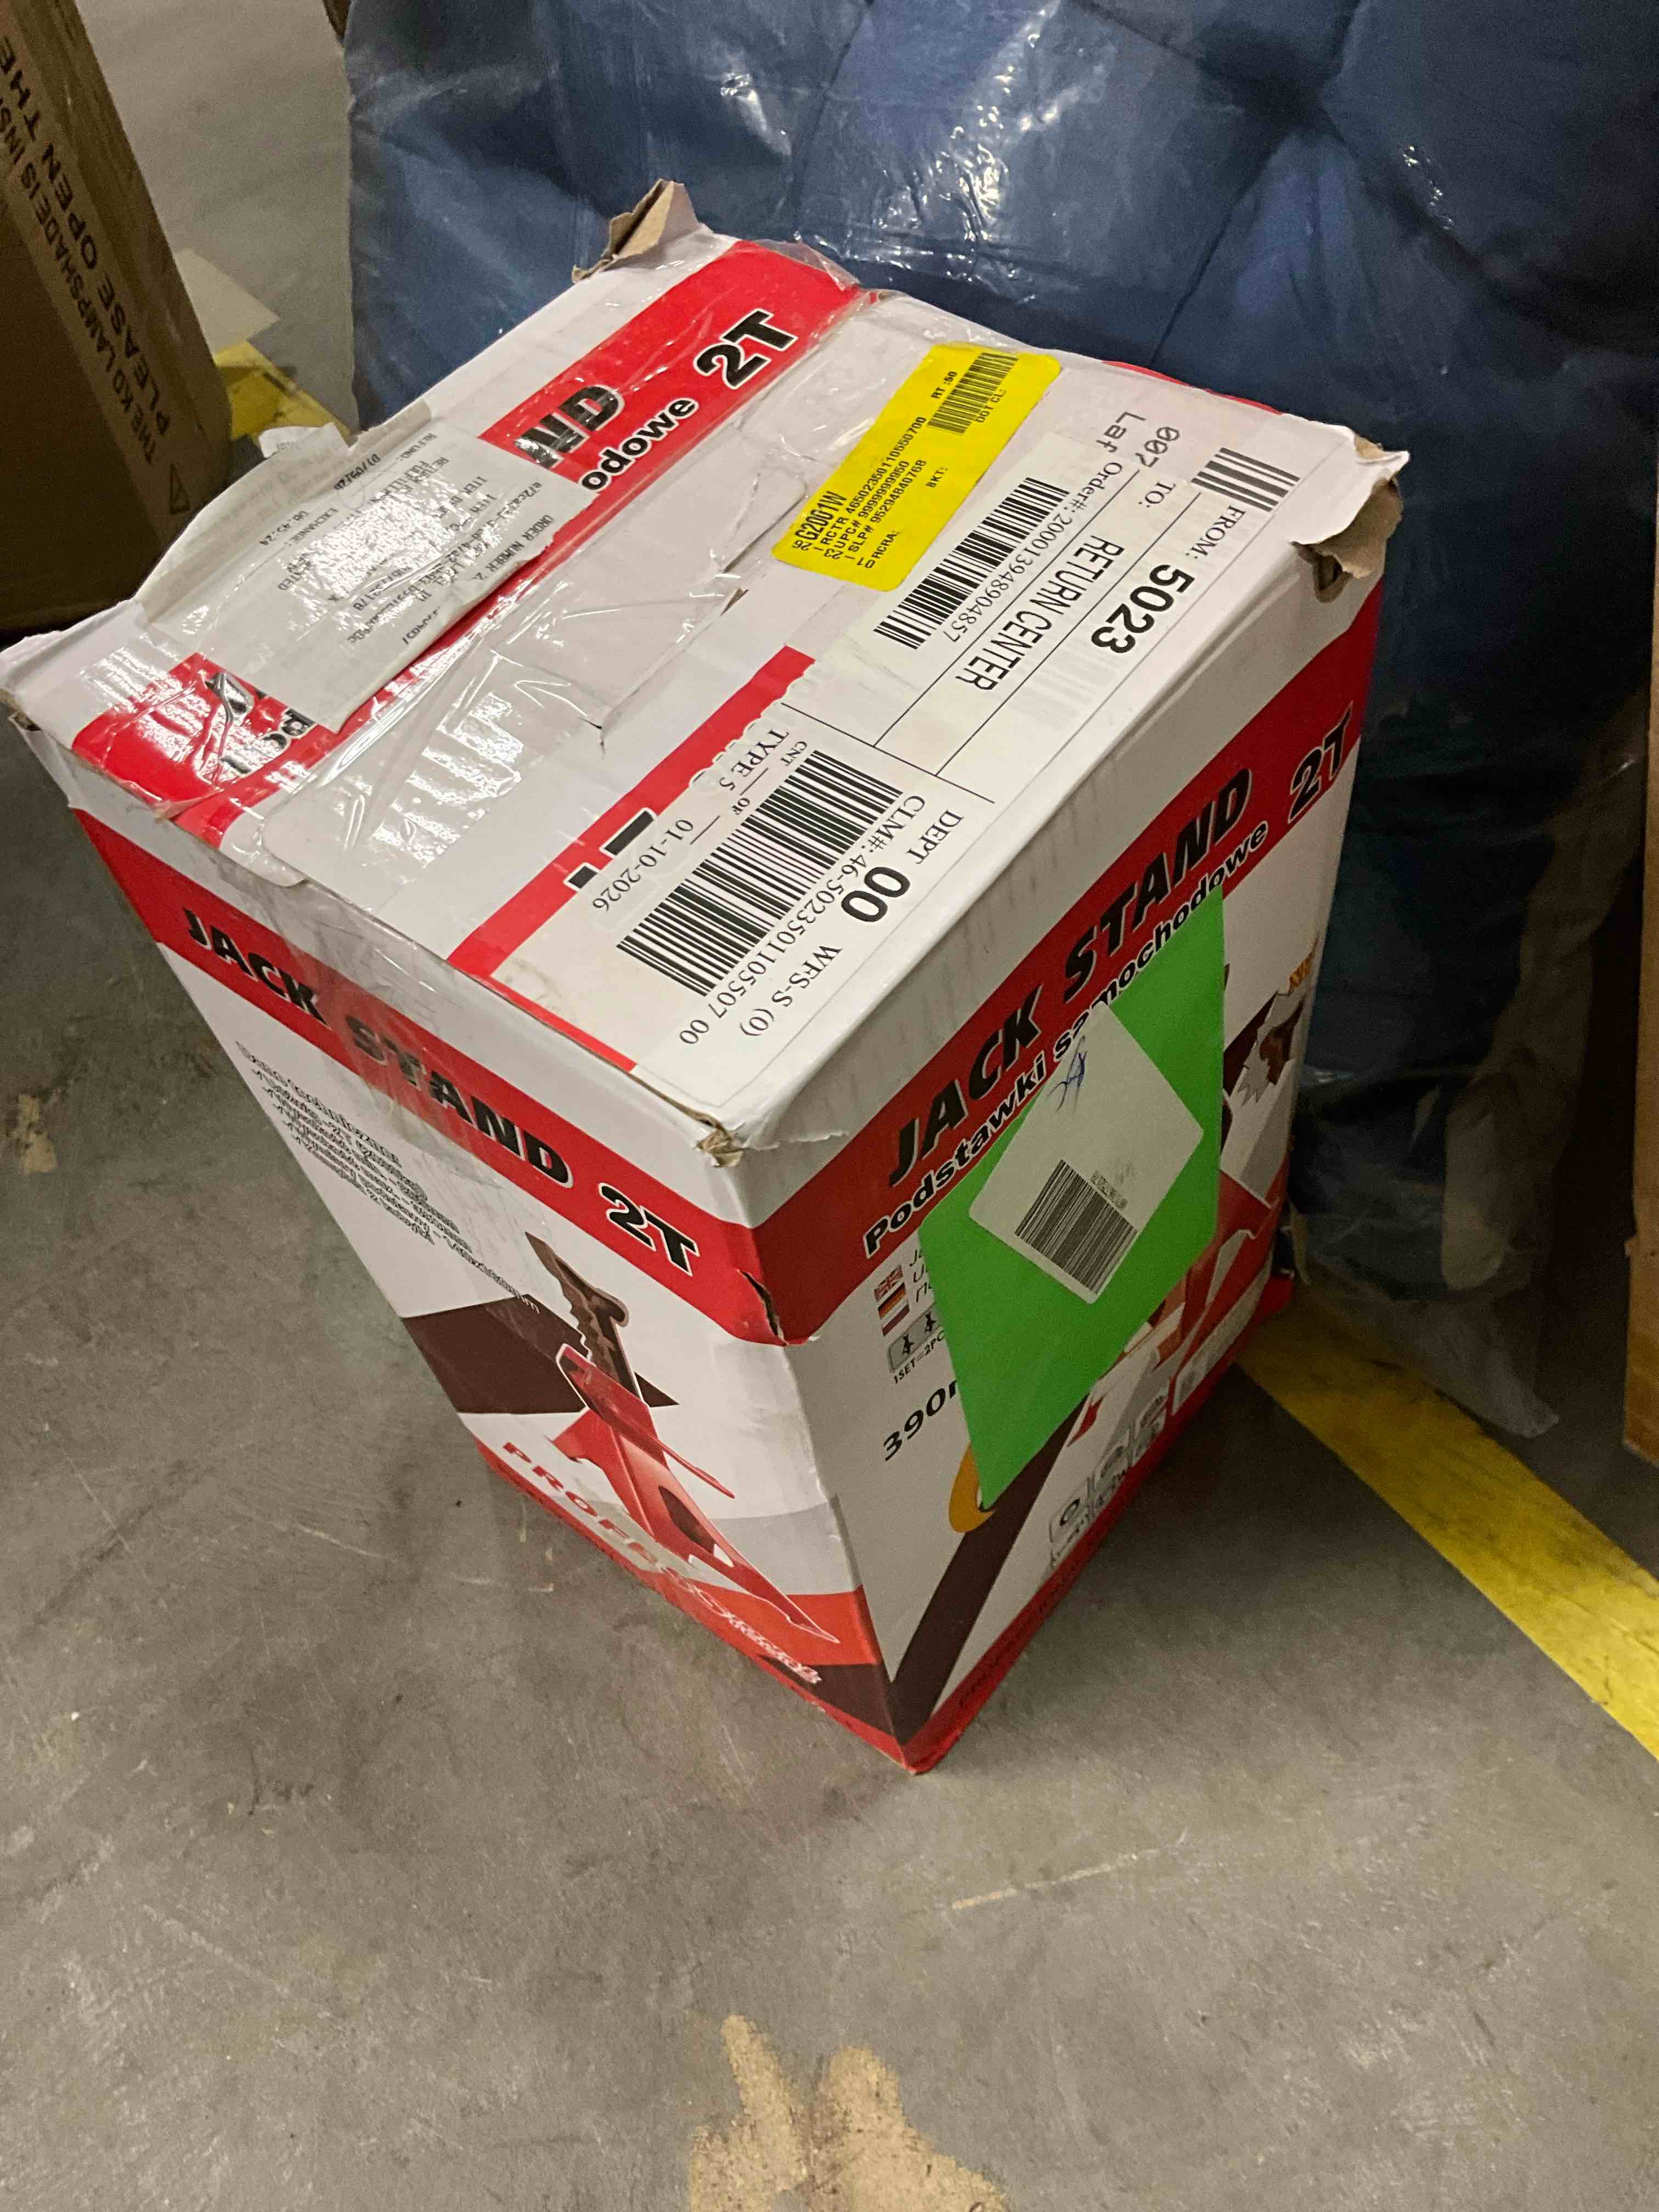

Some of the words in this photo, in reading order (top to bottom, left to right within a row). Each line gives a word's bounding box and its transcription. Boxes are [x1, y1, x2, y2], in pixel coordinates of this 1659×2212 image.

[41, 143, 97, 269] OPEN
[35, 192, 116, 373] LAMPSHADE
[98, 273, 172, 436] PLEASE
[693, 308, 798, 390] 2T
[931, 387, 945, 399] RT
[1096, 411, 1146, 453] Laf
[1135, 427, 1181, 468] 007
[1064, 461, 1123, 514] Order#:
[1138, 481, 1176, 508] TO:
[794, 491, 847, 541] G2001W
[820, 517, 849, 545] RCTR
[833, 520, 862, 549] UPC#
[848, 524, 874, 552] SLP#
[1186, 505, 1247, 559] FROM:
[871, 530, 901, 559] RCRA:
[943, 513, 1073, 643] 200013948904857
[1029, 534, 1125, 615] RETURN
[1091, 564, 1195, 653] 5023
[955, 610, 1053, 691] CENTER
[731, 729, 789, 777] TYPE
[780, 741, 808, 766] CNT
[731, 797, 751, 816] OF
[861, 795, 926, 854] CLM#:
[905, 810, 964, 865] DEPT
[592, 819, 694, 913] 01-10-2026
[841, 866, 911, 923] 00
[708, 853, 867, 1019] 46-5023501105507
[888, 984, 1045, 1187] JACK
[1063, 768, 1252, 1003] STAND
[1288, 701, 1353, 825] 2T
[771, 944, 843, 1008] WFS-S
[679, 1019, 710, 1045] 00
[739, 1008, 775, 1037] (0)
[182, 905, 332, 1031] JACK
[345, 1013, 574, 1188] STAND
[597, 1182, 701, 1277] 2T
[864, 1053, 1047, 1259] Podstawki
